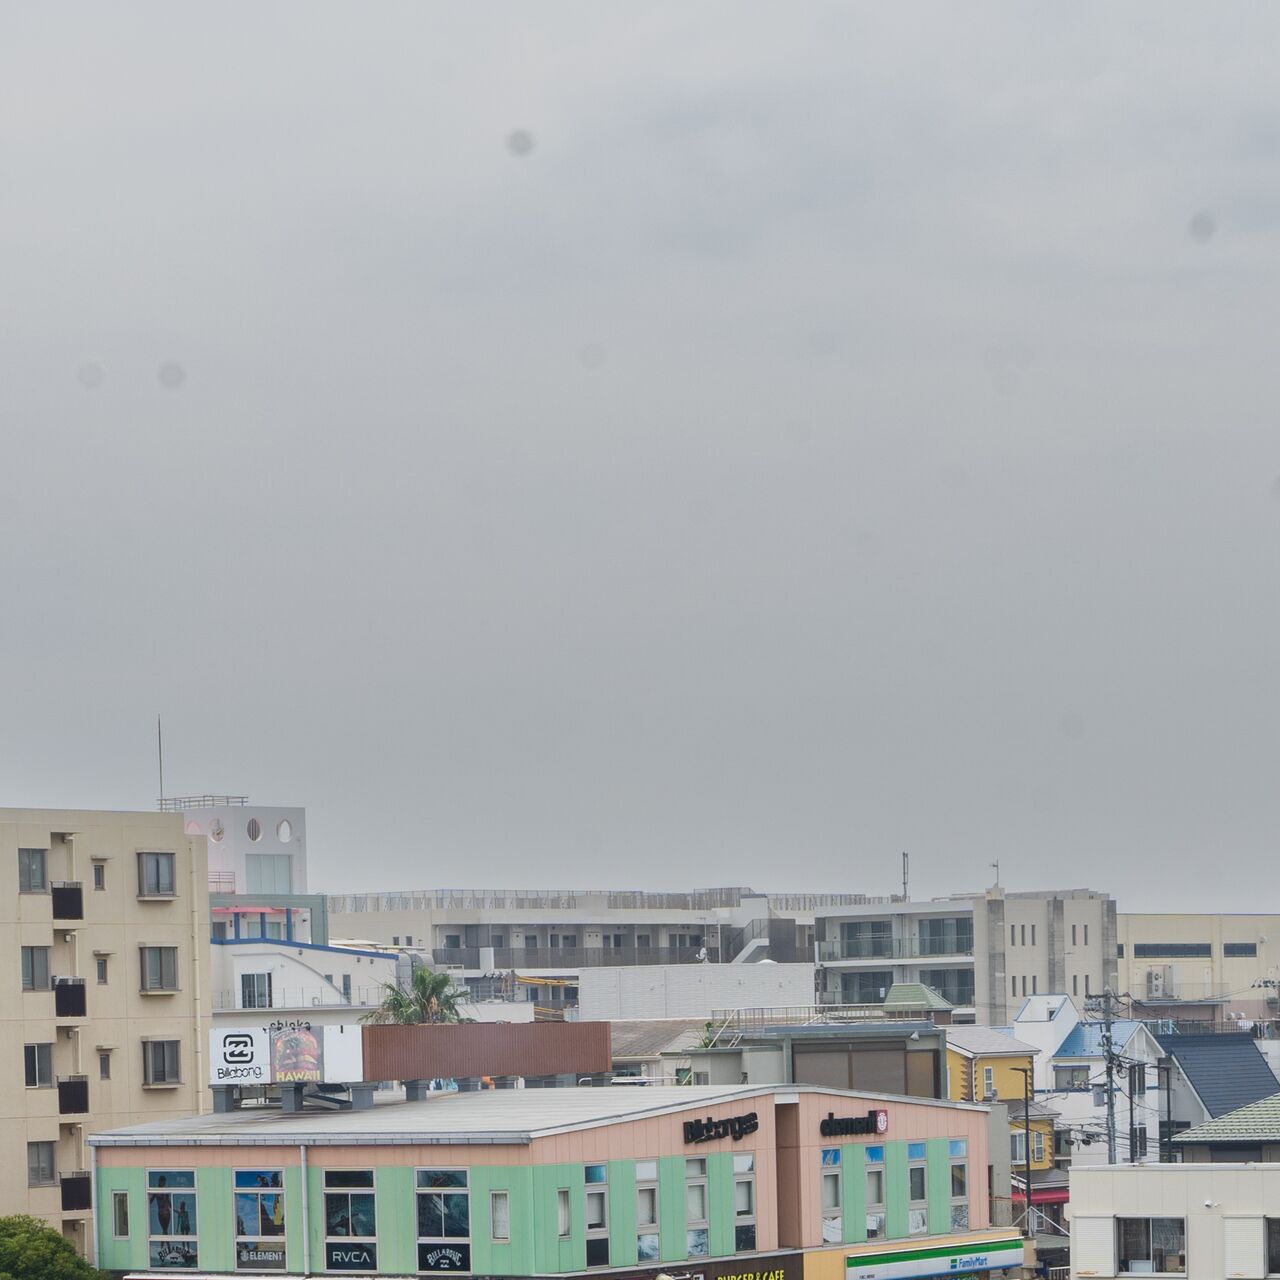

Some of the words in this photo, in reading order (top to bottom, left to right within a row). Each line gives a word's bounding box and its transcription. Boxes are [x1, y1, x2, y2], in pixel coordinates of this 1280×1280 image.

[217, 1066, 263, 1080] Billabong
[276, 1070, 321, 1082] HAWAII
[820, 1111, 877, 1136] element
[250, 1251, 283, 1261] ELEMENT
[332, 1251, 371, 1263] RVCA
[958, 1256, 987, 1268] FamilyMart
